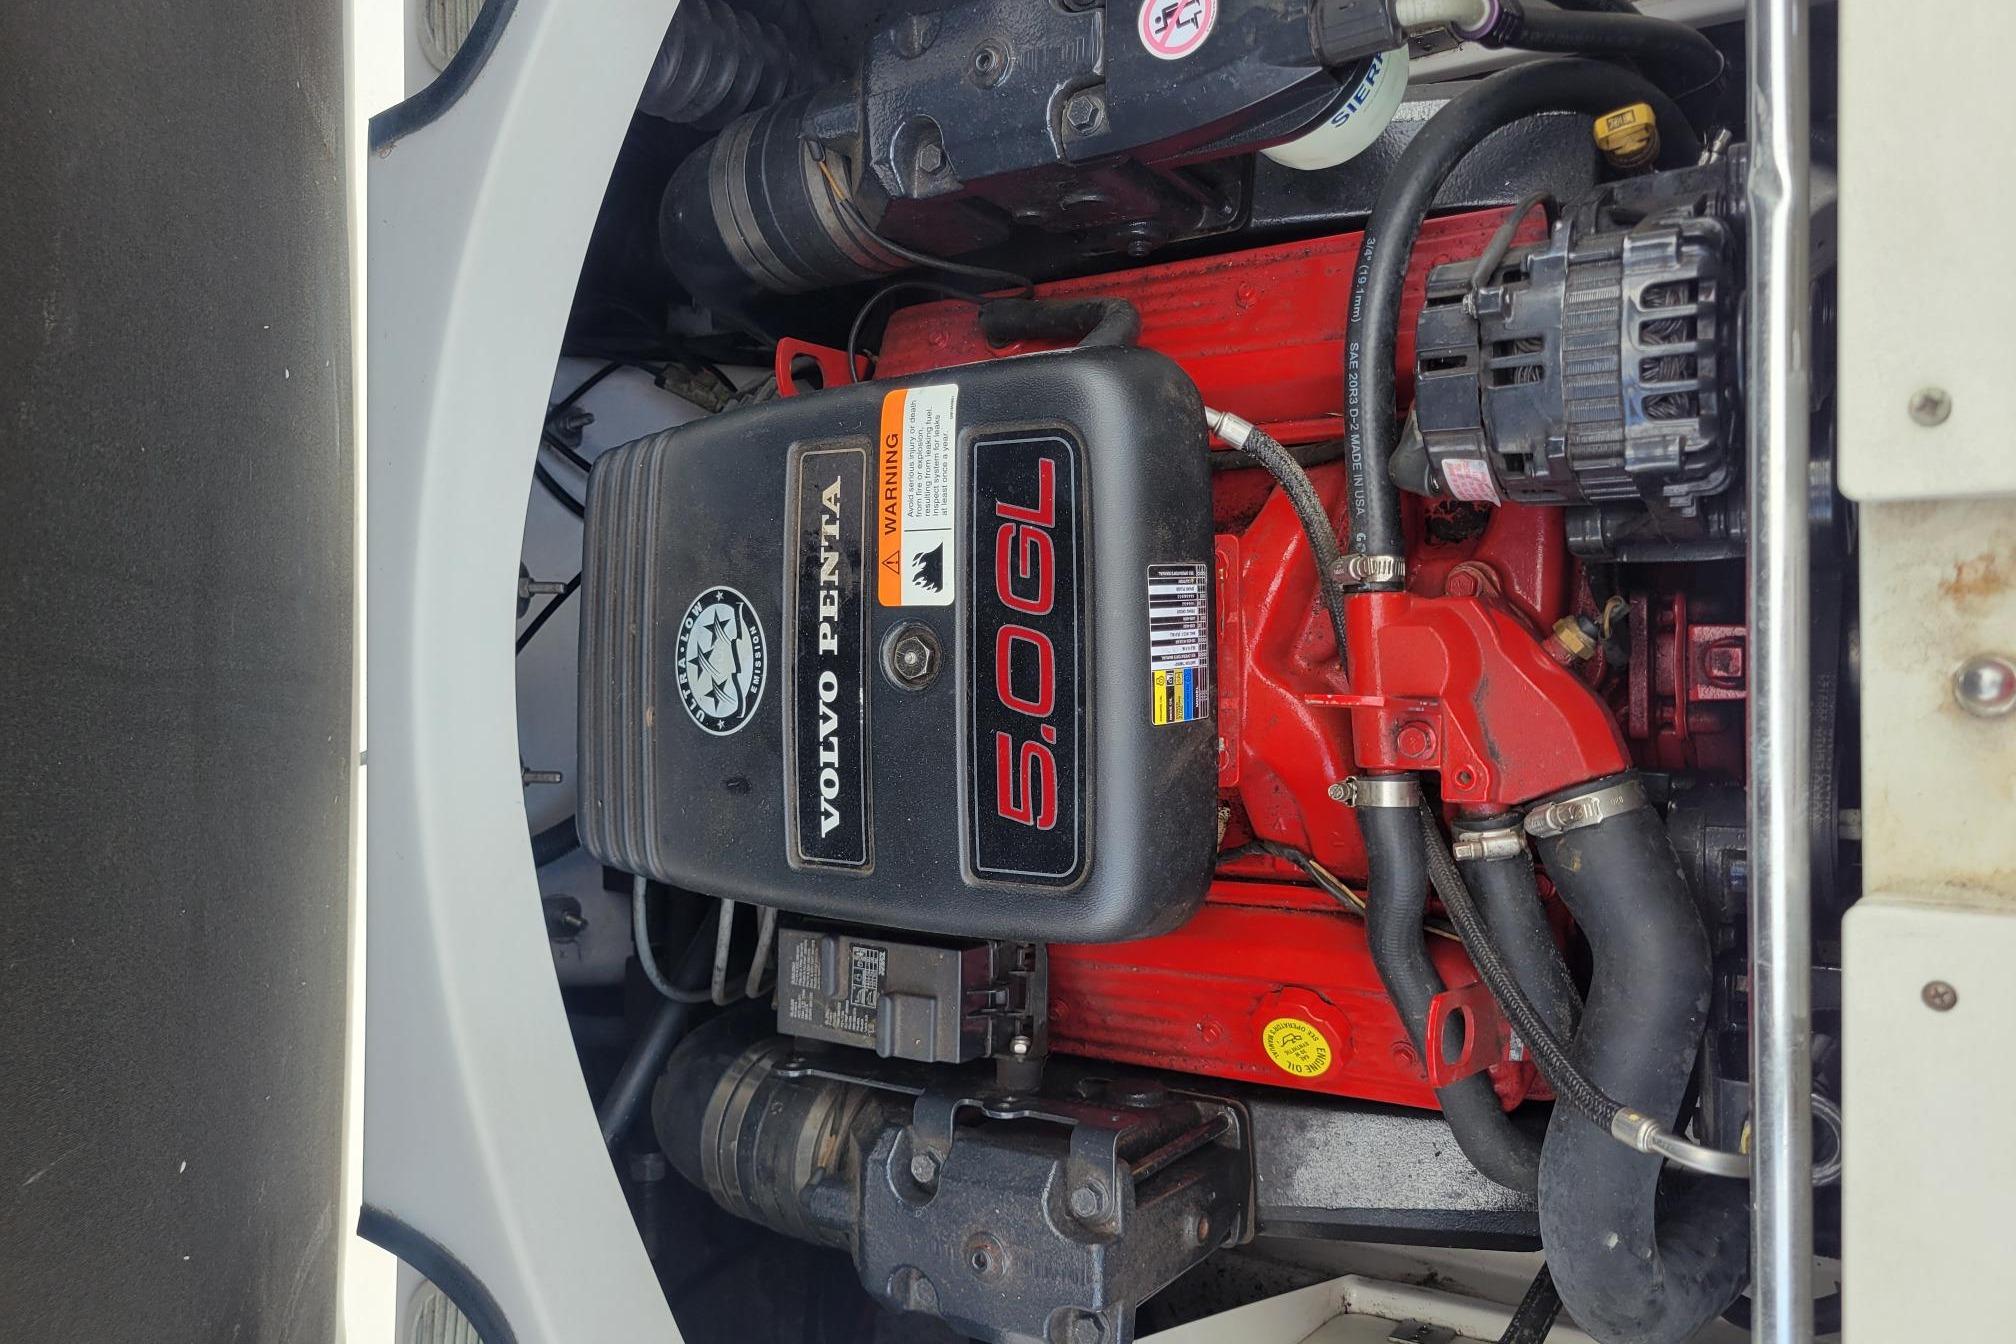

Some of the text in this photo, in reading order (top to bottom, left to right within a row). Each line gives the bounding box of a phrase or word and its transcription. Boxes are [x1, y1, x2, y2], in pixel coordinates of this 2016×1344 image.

[1351, 265, 1369, 322] (19.1mm)
[1349, 343, 1359, 369] SAE
[1349, 373, 1358, 404] 20R3
[910, 425, 915, 434] or
[1349, 409, 1359, 430] D-2
[1351, 434, 1362, 470] MADE
[885, 433, 898, 535] WARNING
[917, 472, 922, 480] or
[1353, 474, 1363, 482] IN
[924, 481, 932, 516] resulting
[1355, 490, 1364, 515] USA
[678, 601, 705, 721] ULTRA LOW
[750, 625, 761, 694] EMISSION
[819, 476, 841, 838] VOLVO PENTA
[1287, 1048, 1325, 1073] ENGINE OIL
